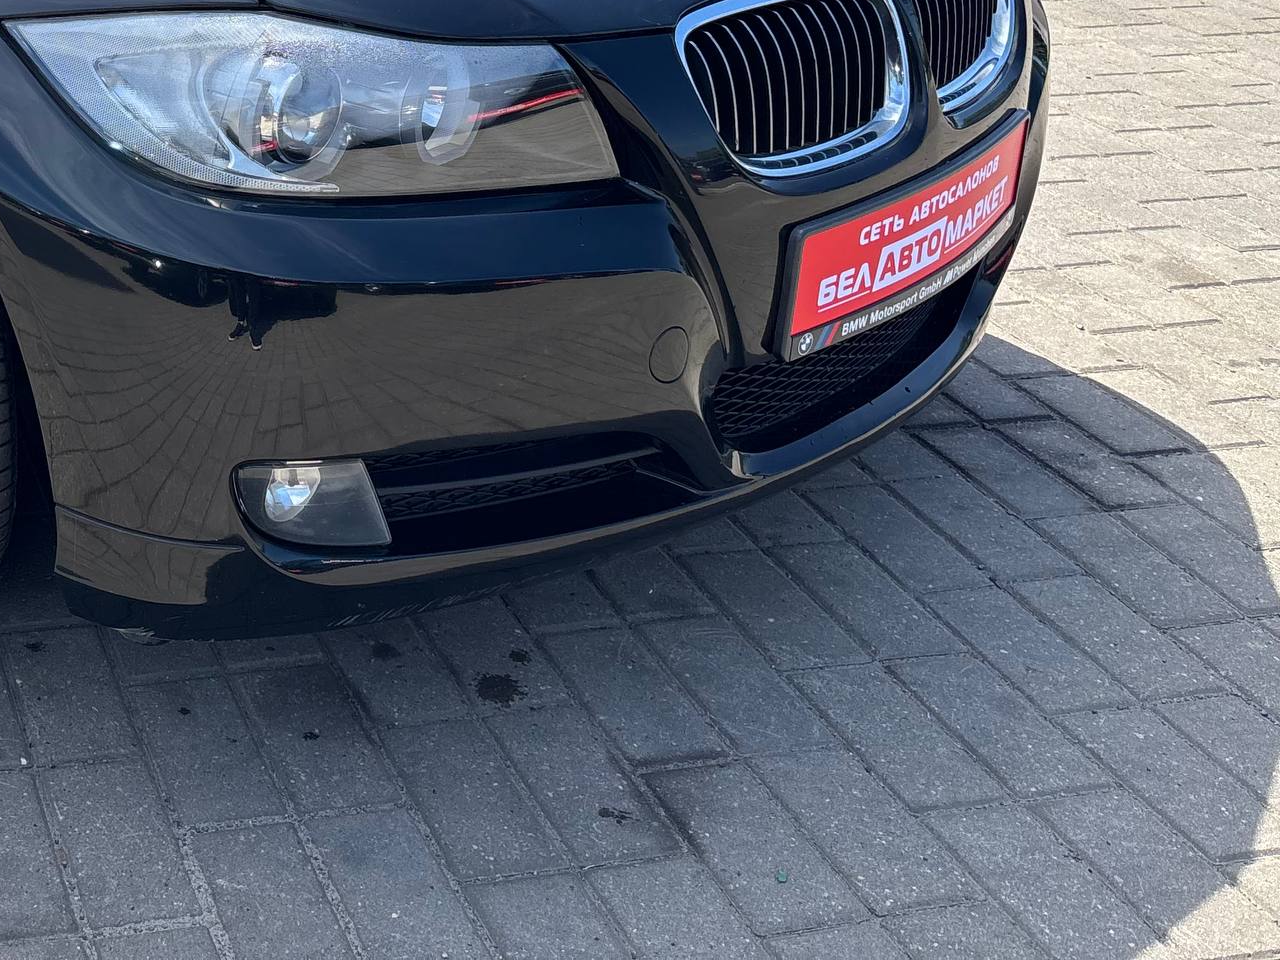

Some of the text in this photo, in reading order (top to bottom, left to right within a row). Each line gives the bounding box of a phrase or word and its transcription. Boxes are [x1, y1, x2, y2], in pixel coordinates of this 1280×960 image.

[859, 154, 1000, 246] СЕТЬ АВТОСАЛОНОВ
[841, 316, 868, 337] BMW
[870, 290, 919, 325] Motorsport
[919, 277, 943, 300] GmbH
